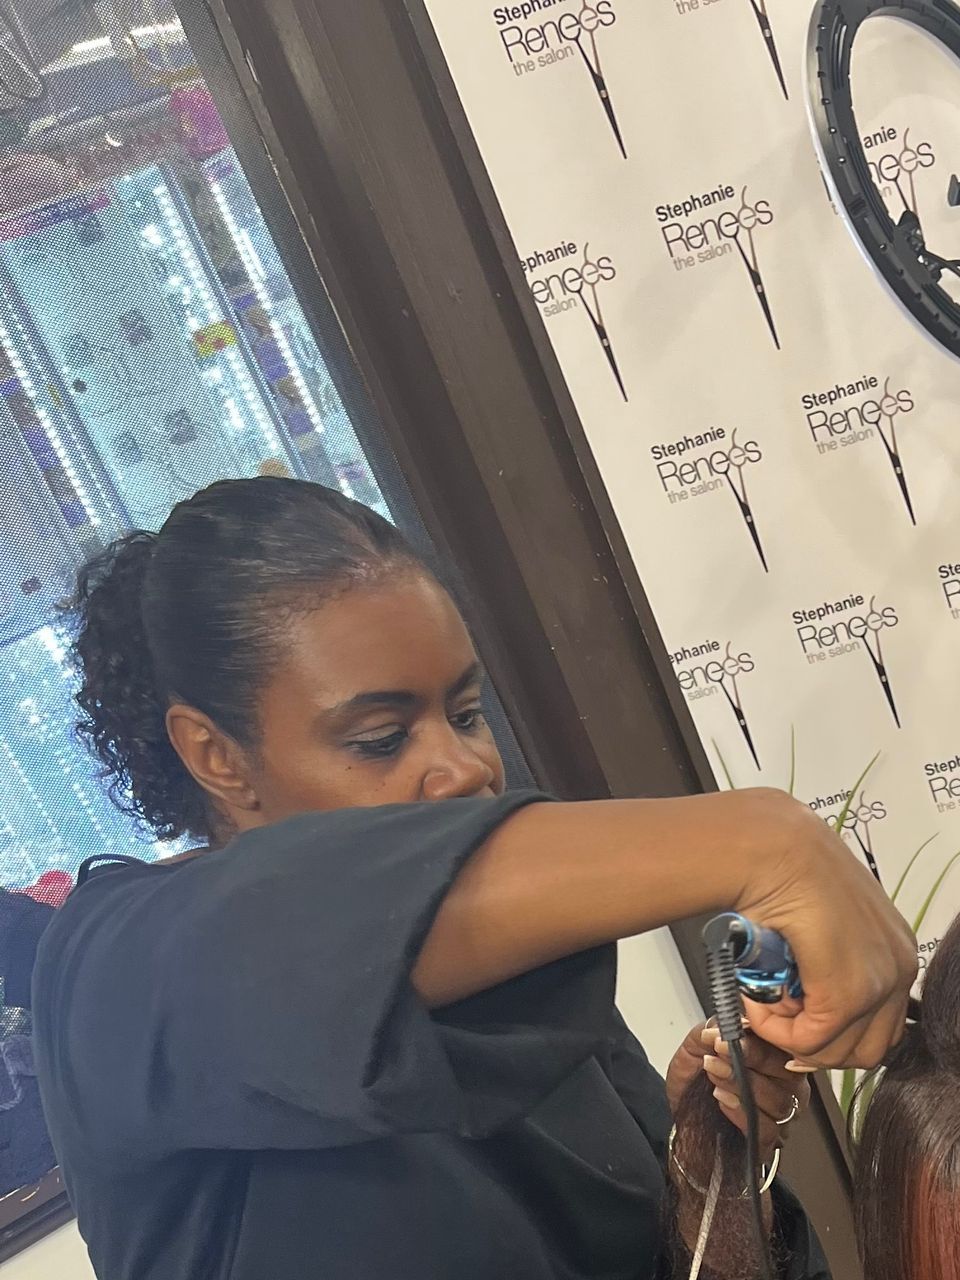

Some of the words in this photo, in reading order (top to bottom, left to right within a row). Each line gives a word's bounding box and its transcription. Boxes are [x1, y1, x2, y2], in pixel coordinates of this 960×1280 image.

[675, 0, 700, 15] the
[499, 1, 616, 62] Renees
[513, 60, 536, 77] the
[537, 45, 575, 68] salon
[655, 184, 735, 222] Stephanie
[661, 200, 773, 258] Renees
[520, 241, 577, 272] ephanie
[673, 255, 696, 271] the
[697, 242, 733, 264] salon
[531, 256, 616, 303] enees
[543, 297, 578, 318] salon
[801, 375, 878, 410] Stephanie
[806, 390, 914, 442] Renees
[650, 426, 726, 461] Stephanie
[816, 438, 838, 455] the
[839, 427, 874, 447] salon
[656, 441, 762, 492] Renees
[667, 490, 689, 504] the
[690, 477, 724, 497] salon
[792, 594, 864, 625] Stephanie
[797, 607, 898, 653] Renees
[669, 639, 720, 665] ephanie
[806, 651, 826, 665] the
[828, 640, 861, 658] salon
[677, 653, 755, 690] enees
[687, 684, 719, 701] salon
[809, 789, 852, 811] phanie
[937, 800, 956, 814] the
